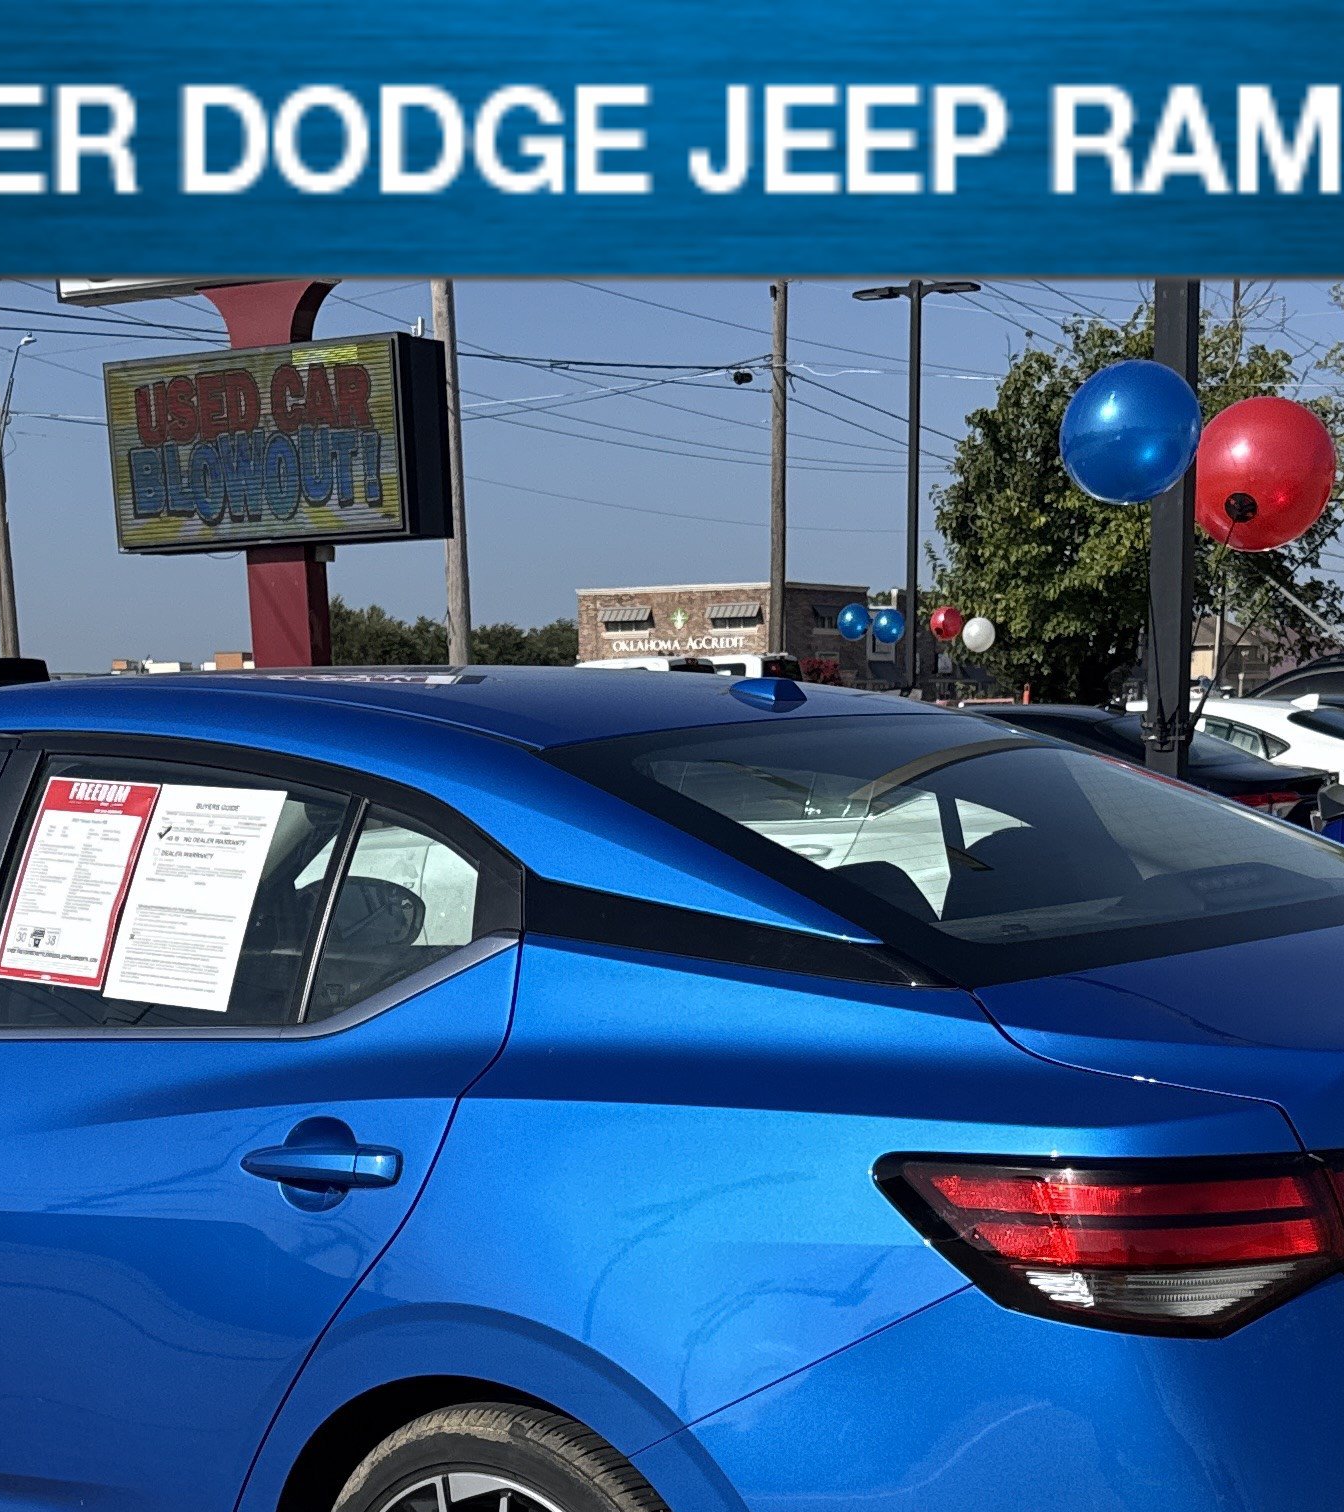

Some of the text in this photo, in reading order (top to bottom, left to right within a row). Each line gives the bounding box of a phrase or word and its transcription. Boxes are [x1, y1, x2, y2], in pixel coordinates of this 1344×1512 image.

[134, 363, 374, 448] USED CAR
[130, 424, 382, 526] BLOWOUT!
[613, 638, 682, 652] OKLAHOMA
[68, 781, 132, 804] FREEDOM
